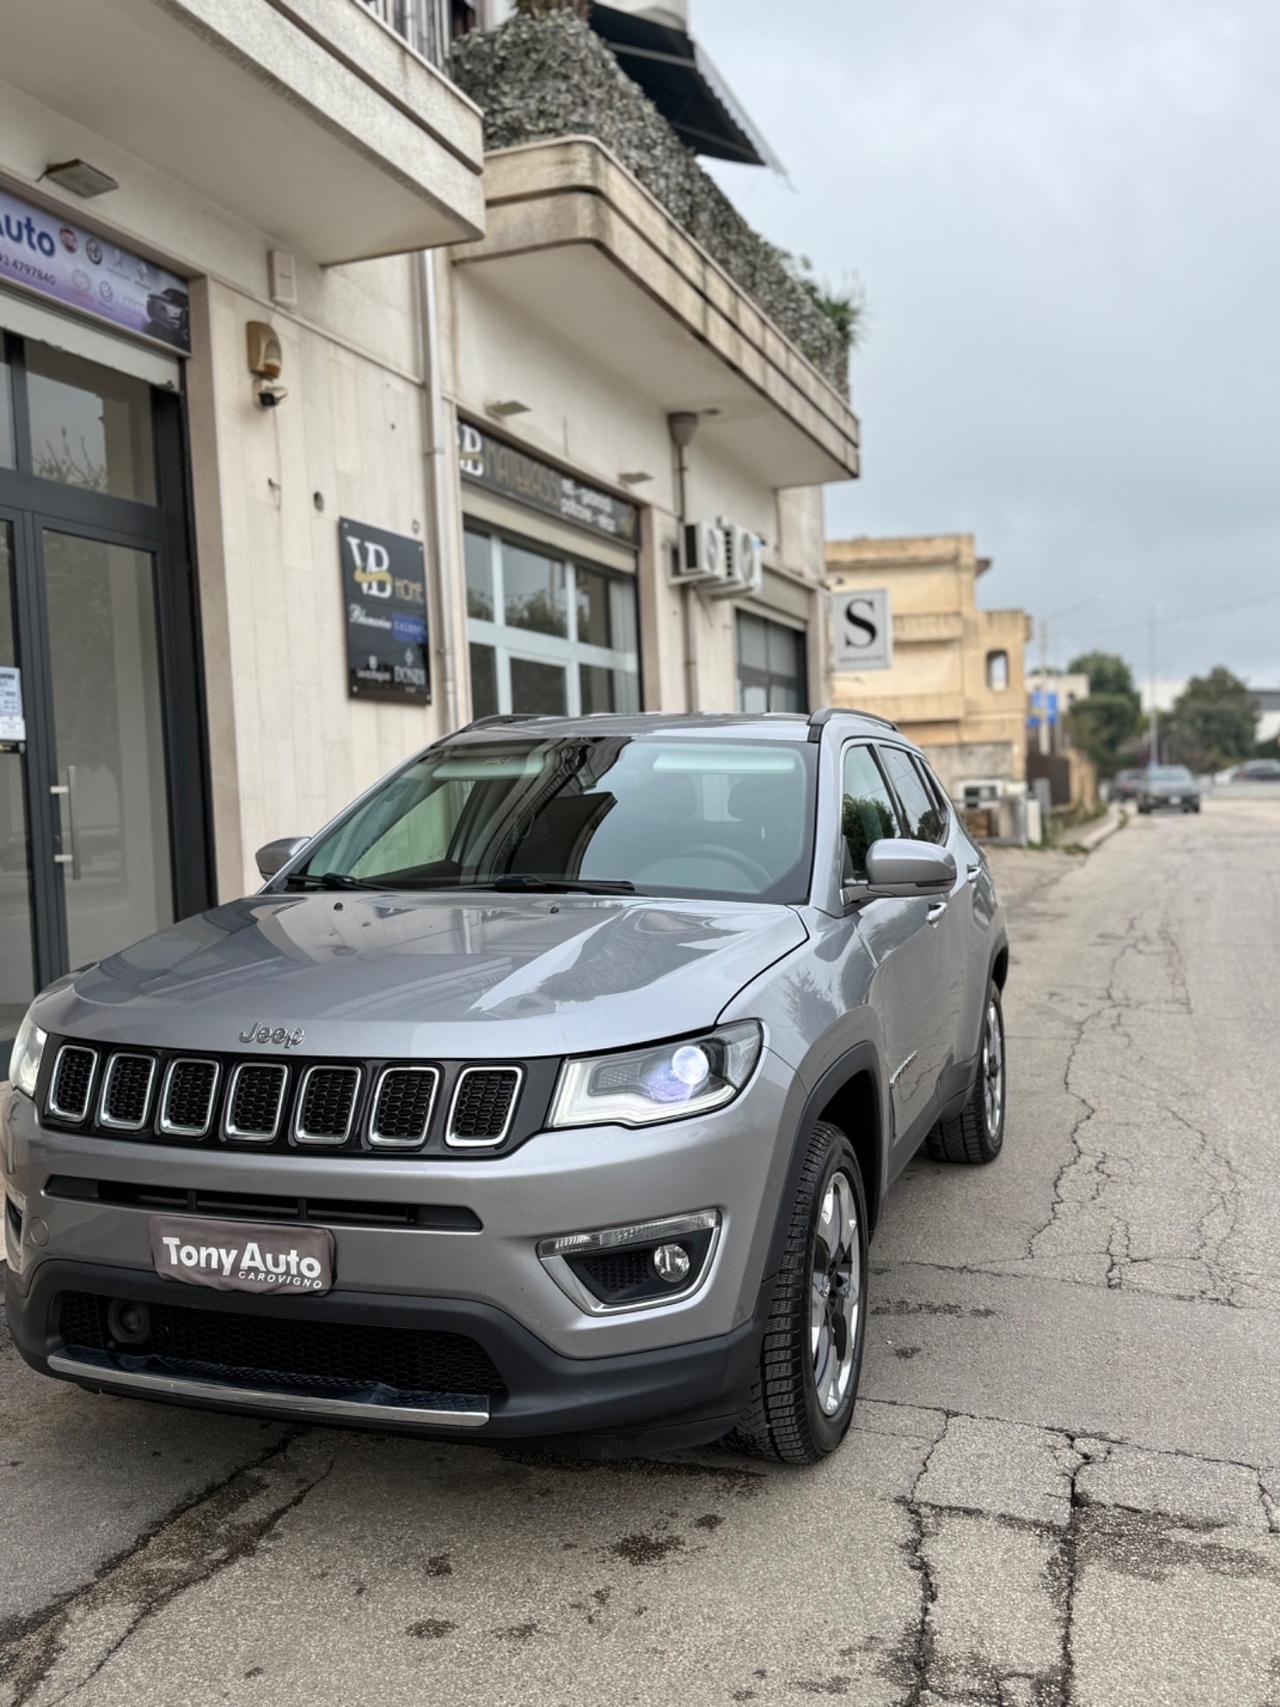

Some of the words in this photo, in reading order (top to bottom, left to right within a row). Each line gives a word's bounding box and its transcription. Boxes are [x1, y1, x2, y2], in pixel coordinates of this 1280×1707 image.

[0, 213, 55, 257] uto
[844, 597, 877, 650] S
[239, 1021, 305, 1049] Jeep
[238, 1270, 322, 1289] CAROVIGNO
